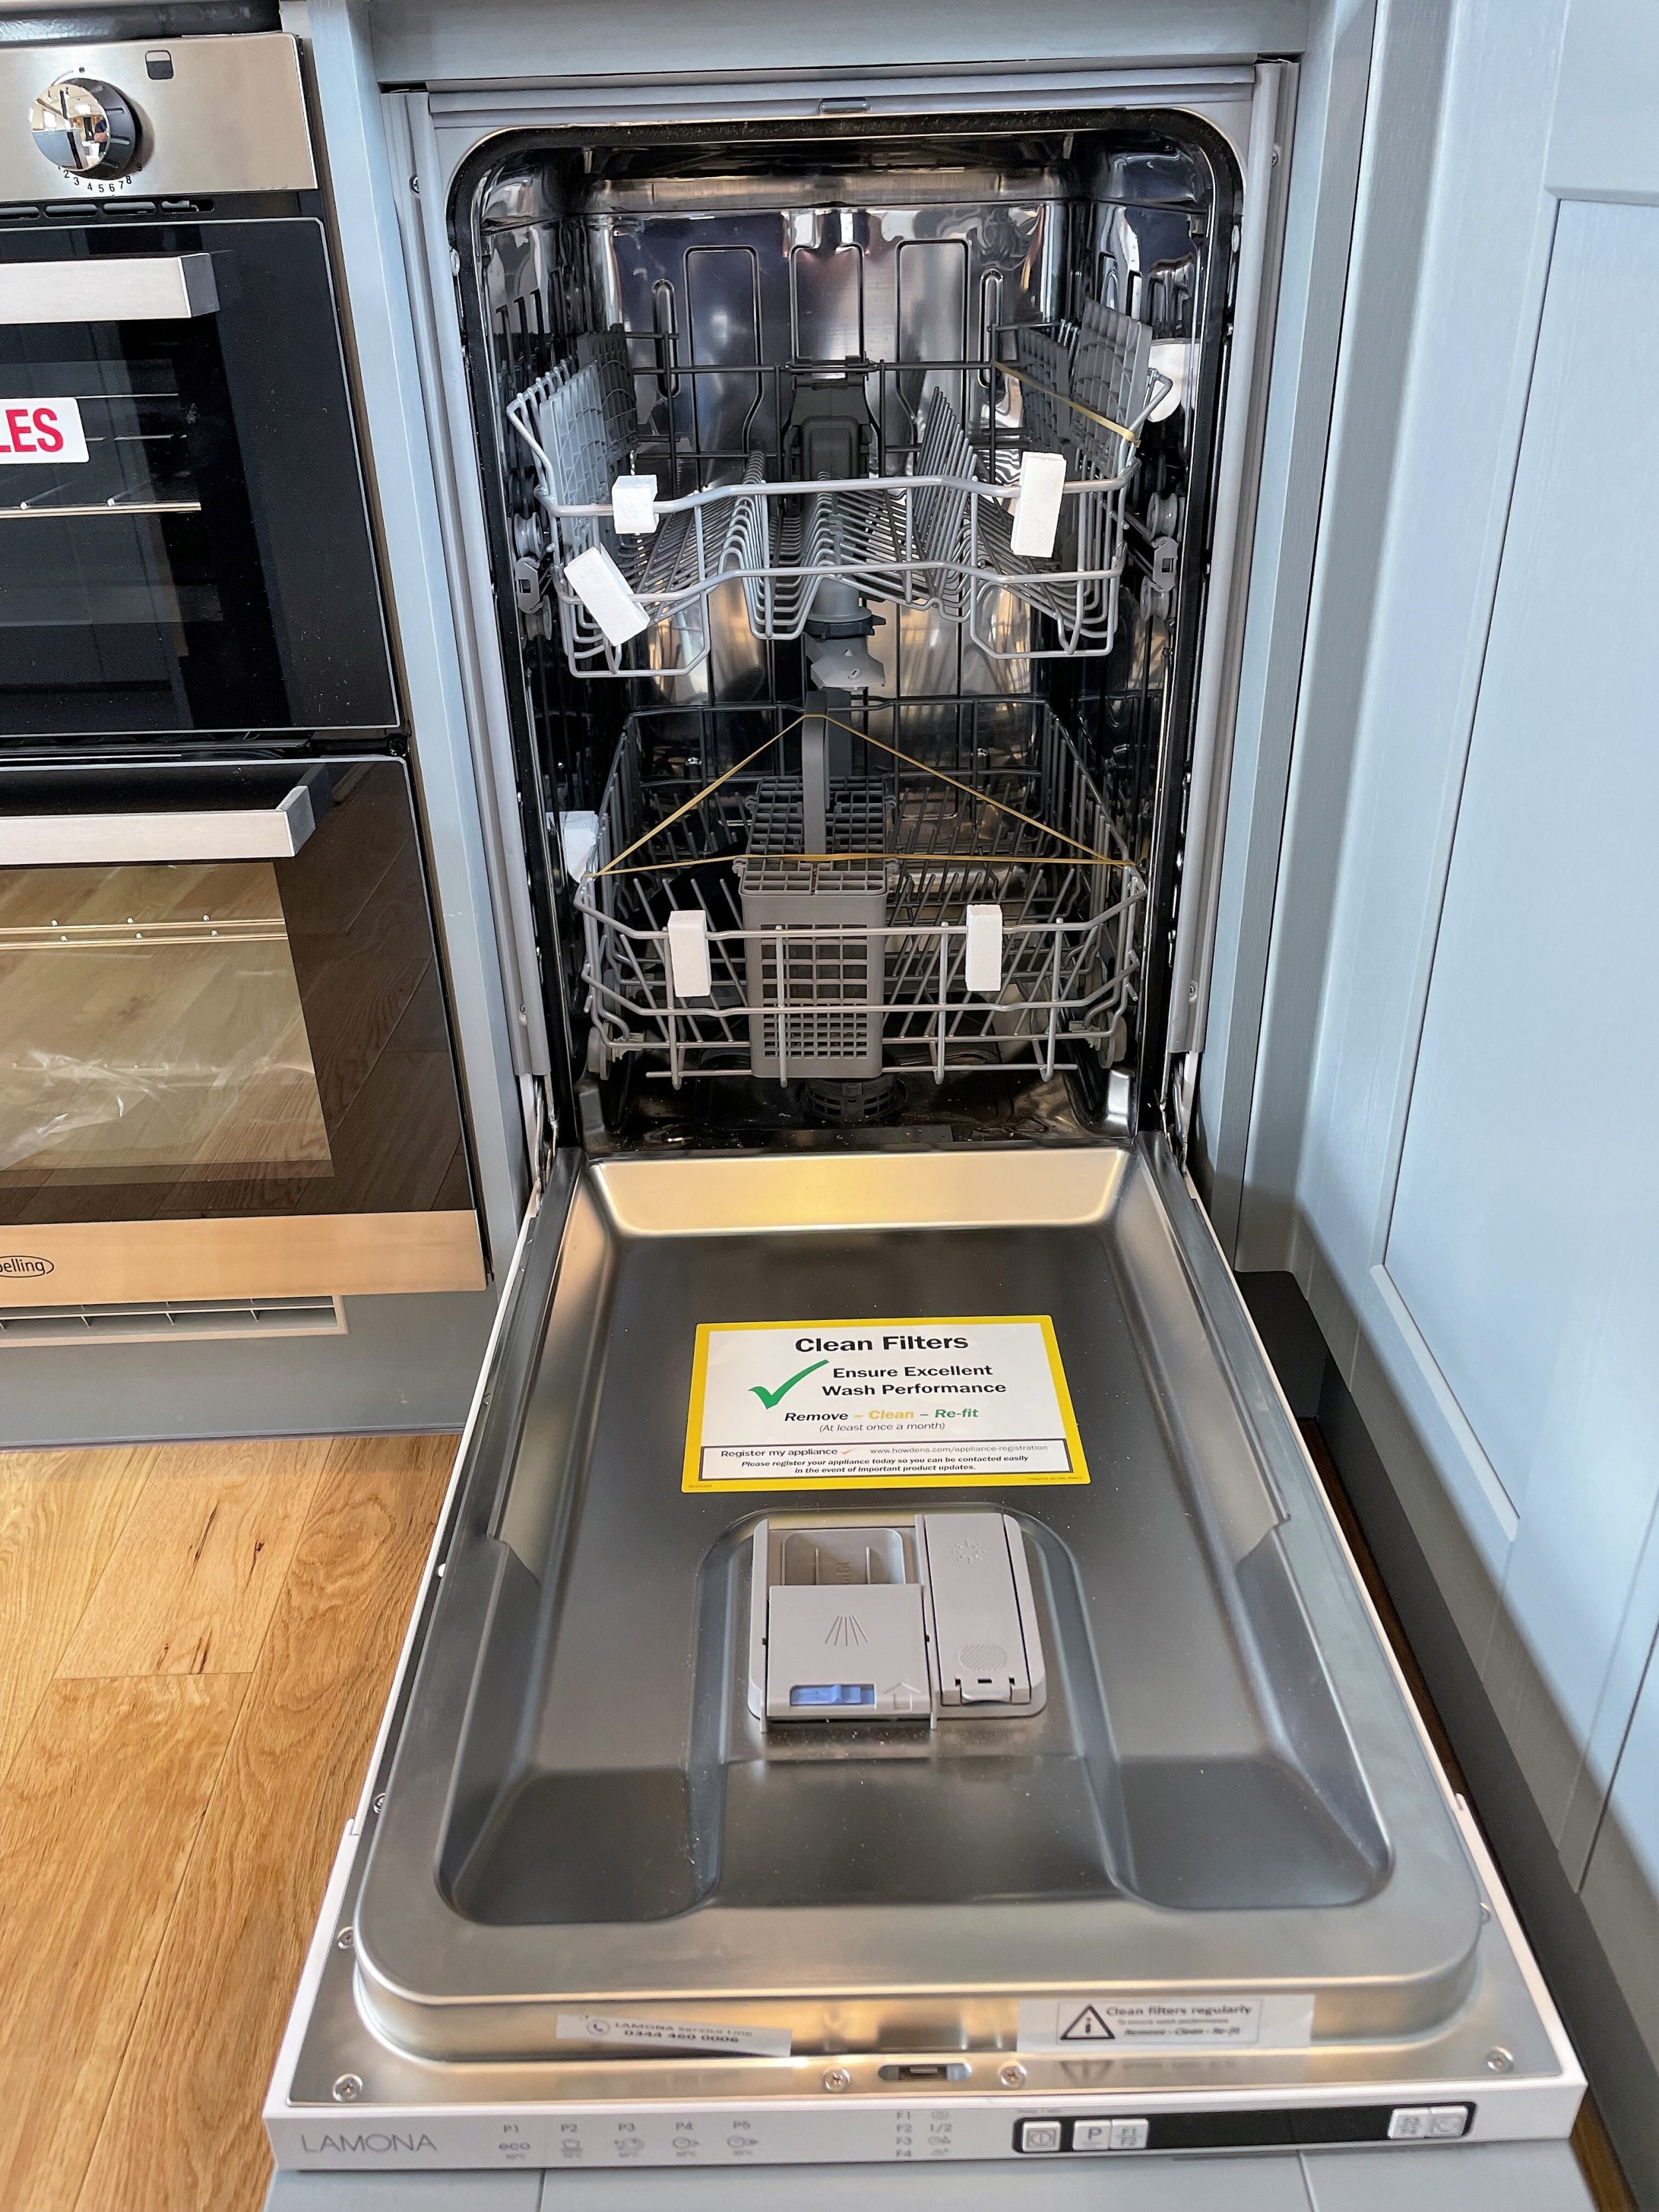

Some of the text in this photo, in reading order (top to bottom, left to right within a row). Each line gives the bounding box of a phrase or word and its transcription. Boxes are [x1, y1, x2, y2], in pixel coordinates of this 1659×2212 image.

[63, 170, 70, 179] 2
[74, 177, 80, 186] 3
[87, 183, 93, 191] 4
[125, 175, 131, 184] 8
[137, 163, 143, 172] 9
[0, 407, 64, 453] ES
[795, 1335, 969, 1352] Clean Filters
[833, 1365, 993, 1378] Ensure Excellent
[822, 1383, 1007, 1396] Wash Performance
[784, 1412, 849, 1422] Remove
[869, 1410, 914, 1420] Clean
[935, 1408, 979, 1418] Re-fit
[820, 1424, 833, 1433] (At
[906, 1422, 945, 1431] month)
[721, 1449, 764, 1458] Register
[788, 1448, 837, 1457] appliance
[870, 1444, 1048, 1454] www.howdens.com/appliance-registration
[858, 1464, 901, 1473] important
[1106, 2004, 1252, 2017] Clean filters regularly
[615, 2022, 674, 2031] LAMONA
[503, 2124, 519, 2133] P1
[561, 2124, 577, 2133] P2
[618, 2122, 635, 2132] P3
[676, 2122, 693, 2130] P4
[1088, 2127, 1102, 2140] P
[301, 2133, 437, 2152] LAMONA
